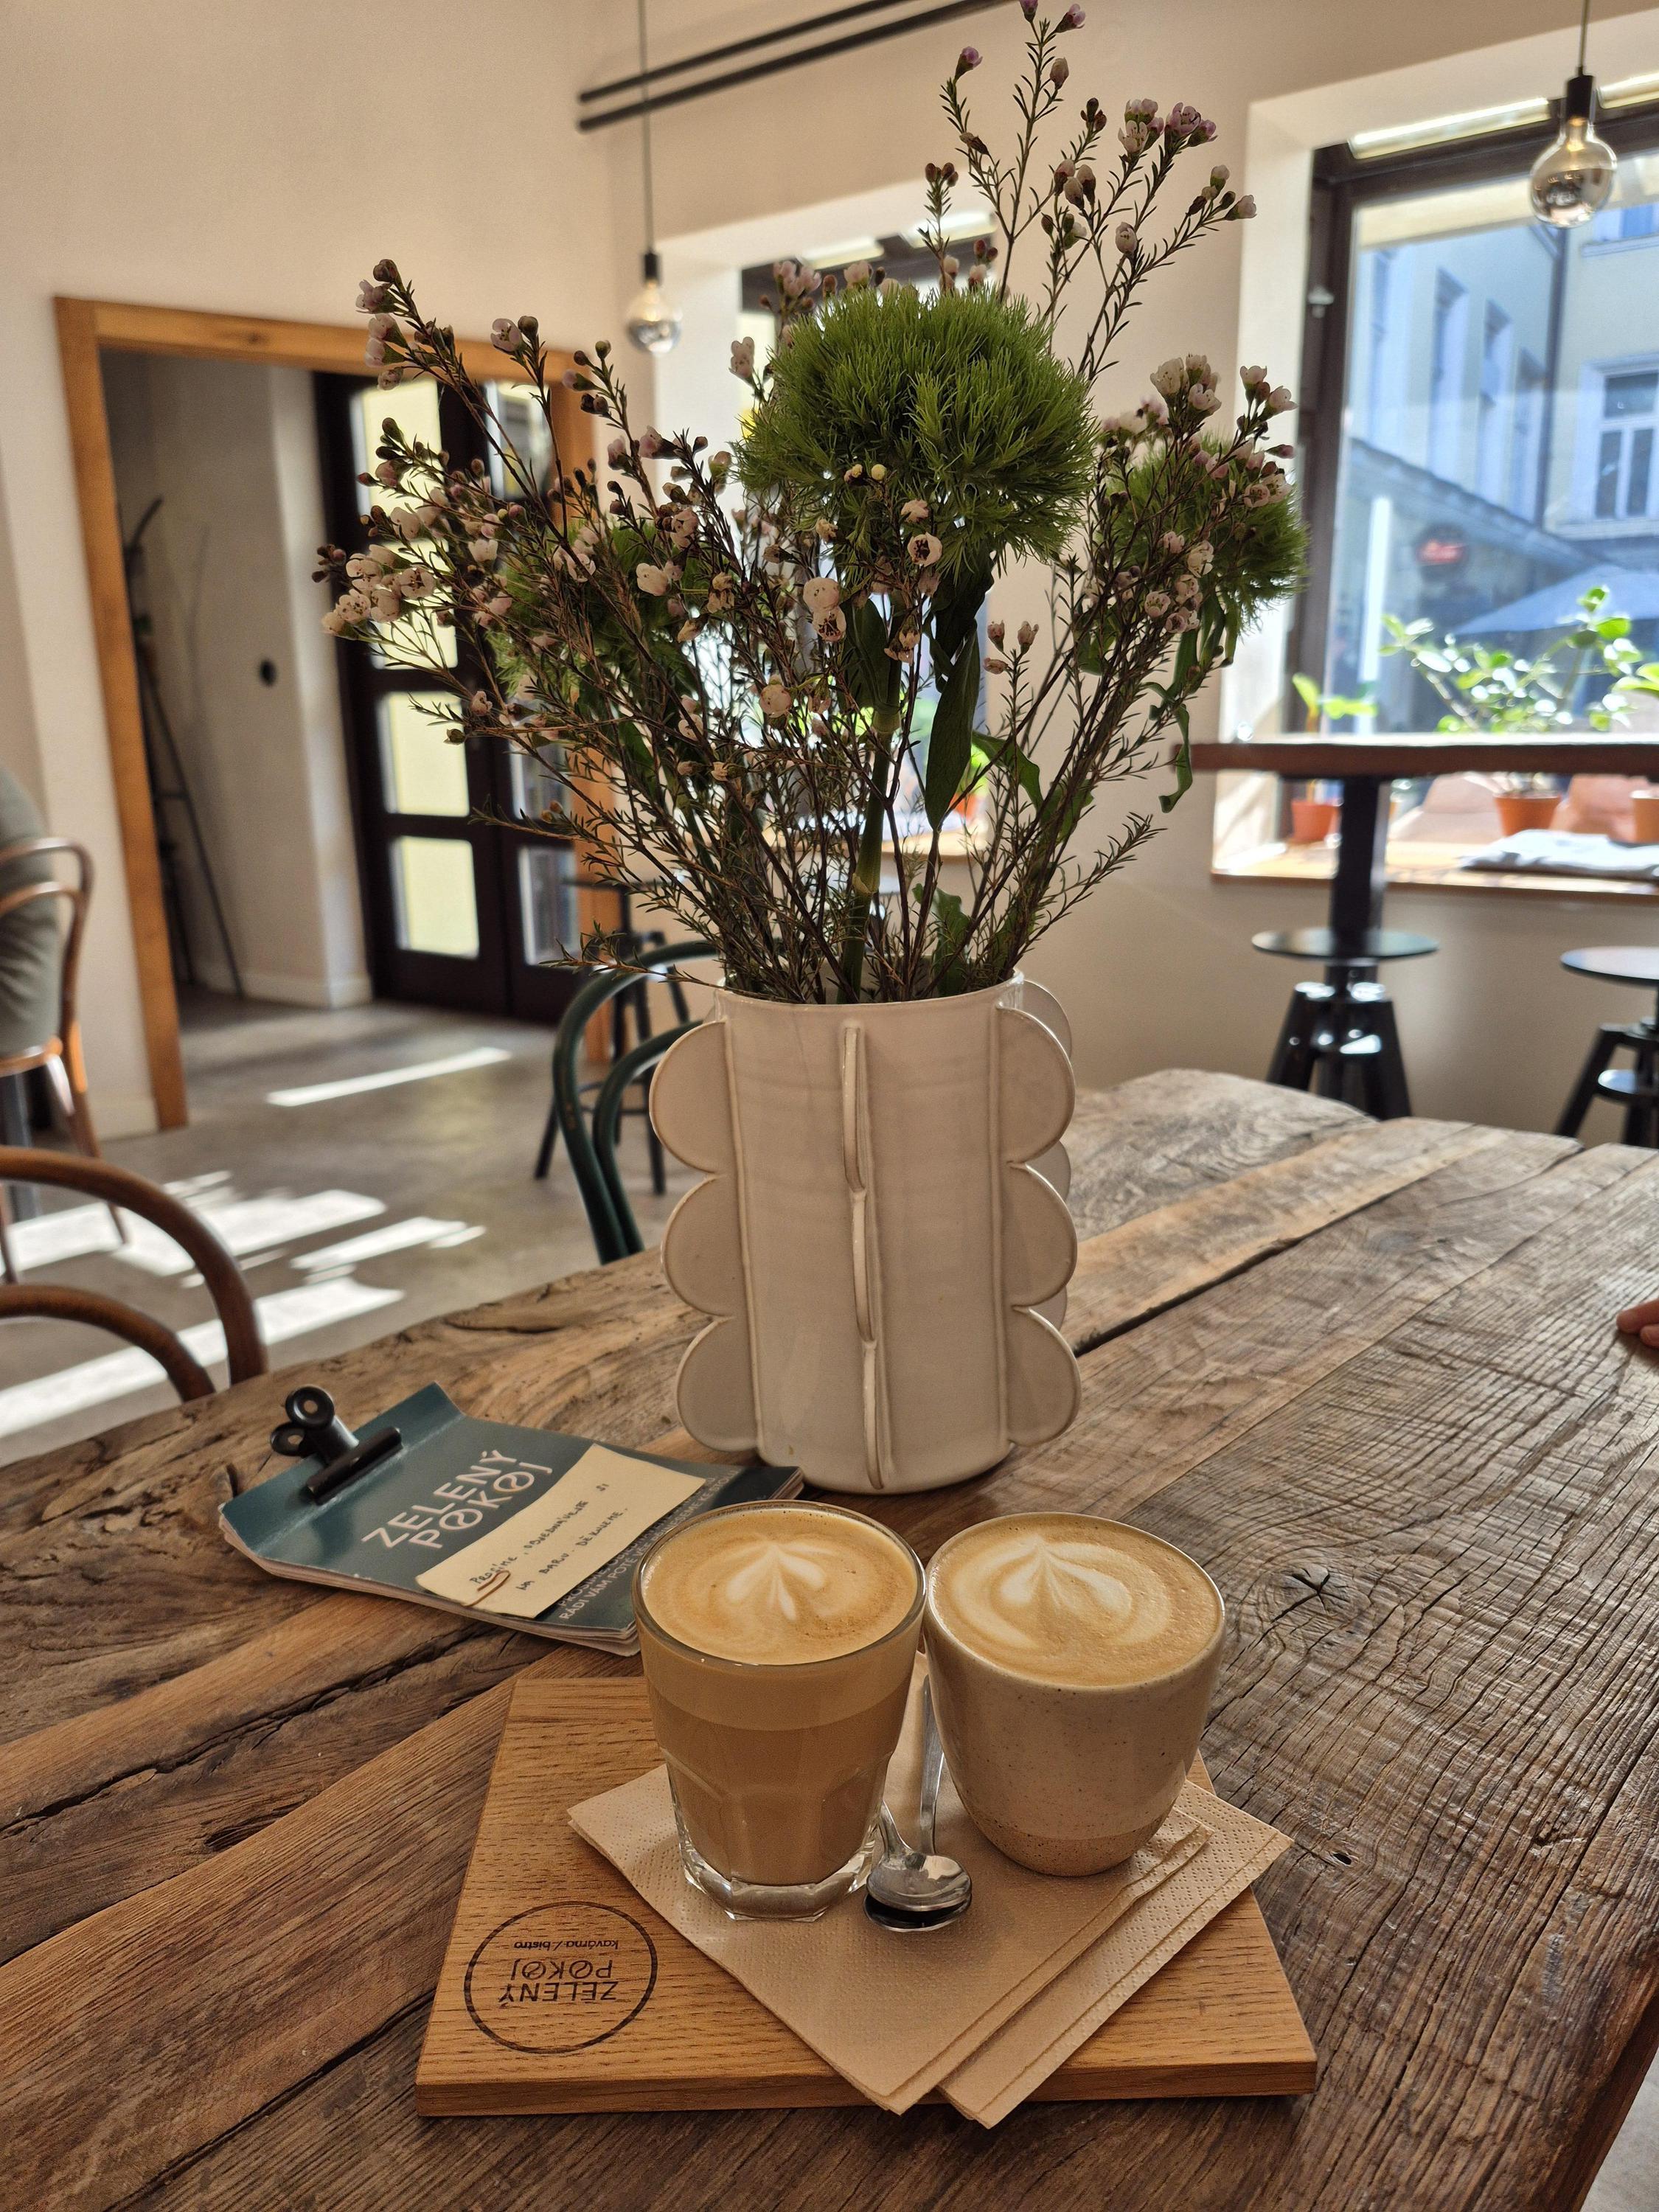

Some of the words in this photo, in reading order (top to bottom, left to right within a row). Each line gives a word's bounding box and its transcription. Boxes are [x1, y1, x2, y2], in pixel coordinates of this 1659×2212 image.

[361, 1450, 517, 1548] ZELENÝ
[408, 1462, 553, 1548] POKOJ
[559, 1599, 589, 1619] RÁDI
[583, 1579, 613, 1598] VÁM
[608, 1557, 637, 1580] POTÉ
[514, 1941, 552, 1950] bistro
[510, 1958, 613, 1981] POKOJ
[498, 1980, 619, 2009] ZELENÝ
